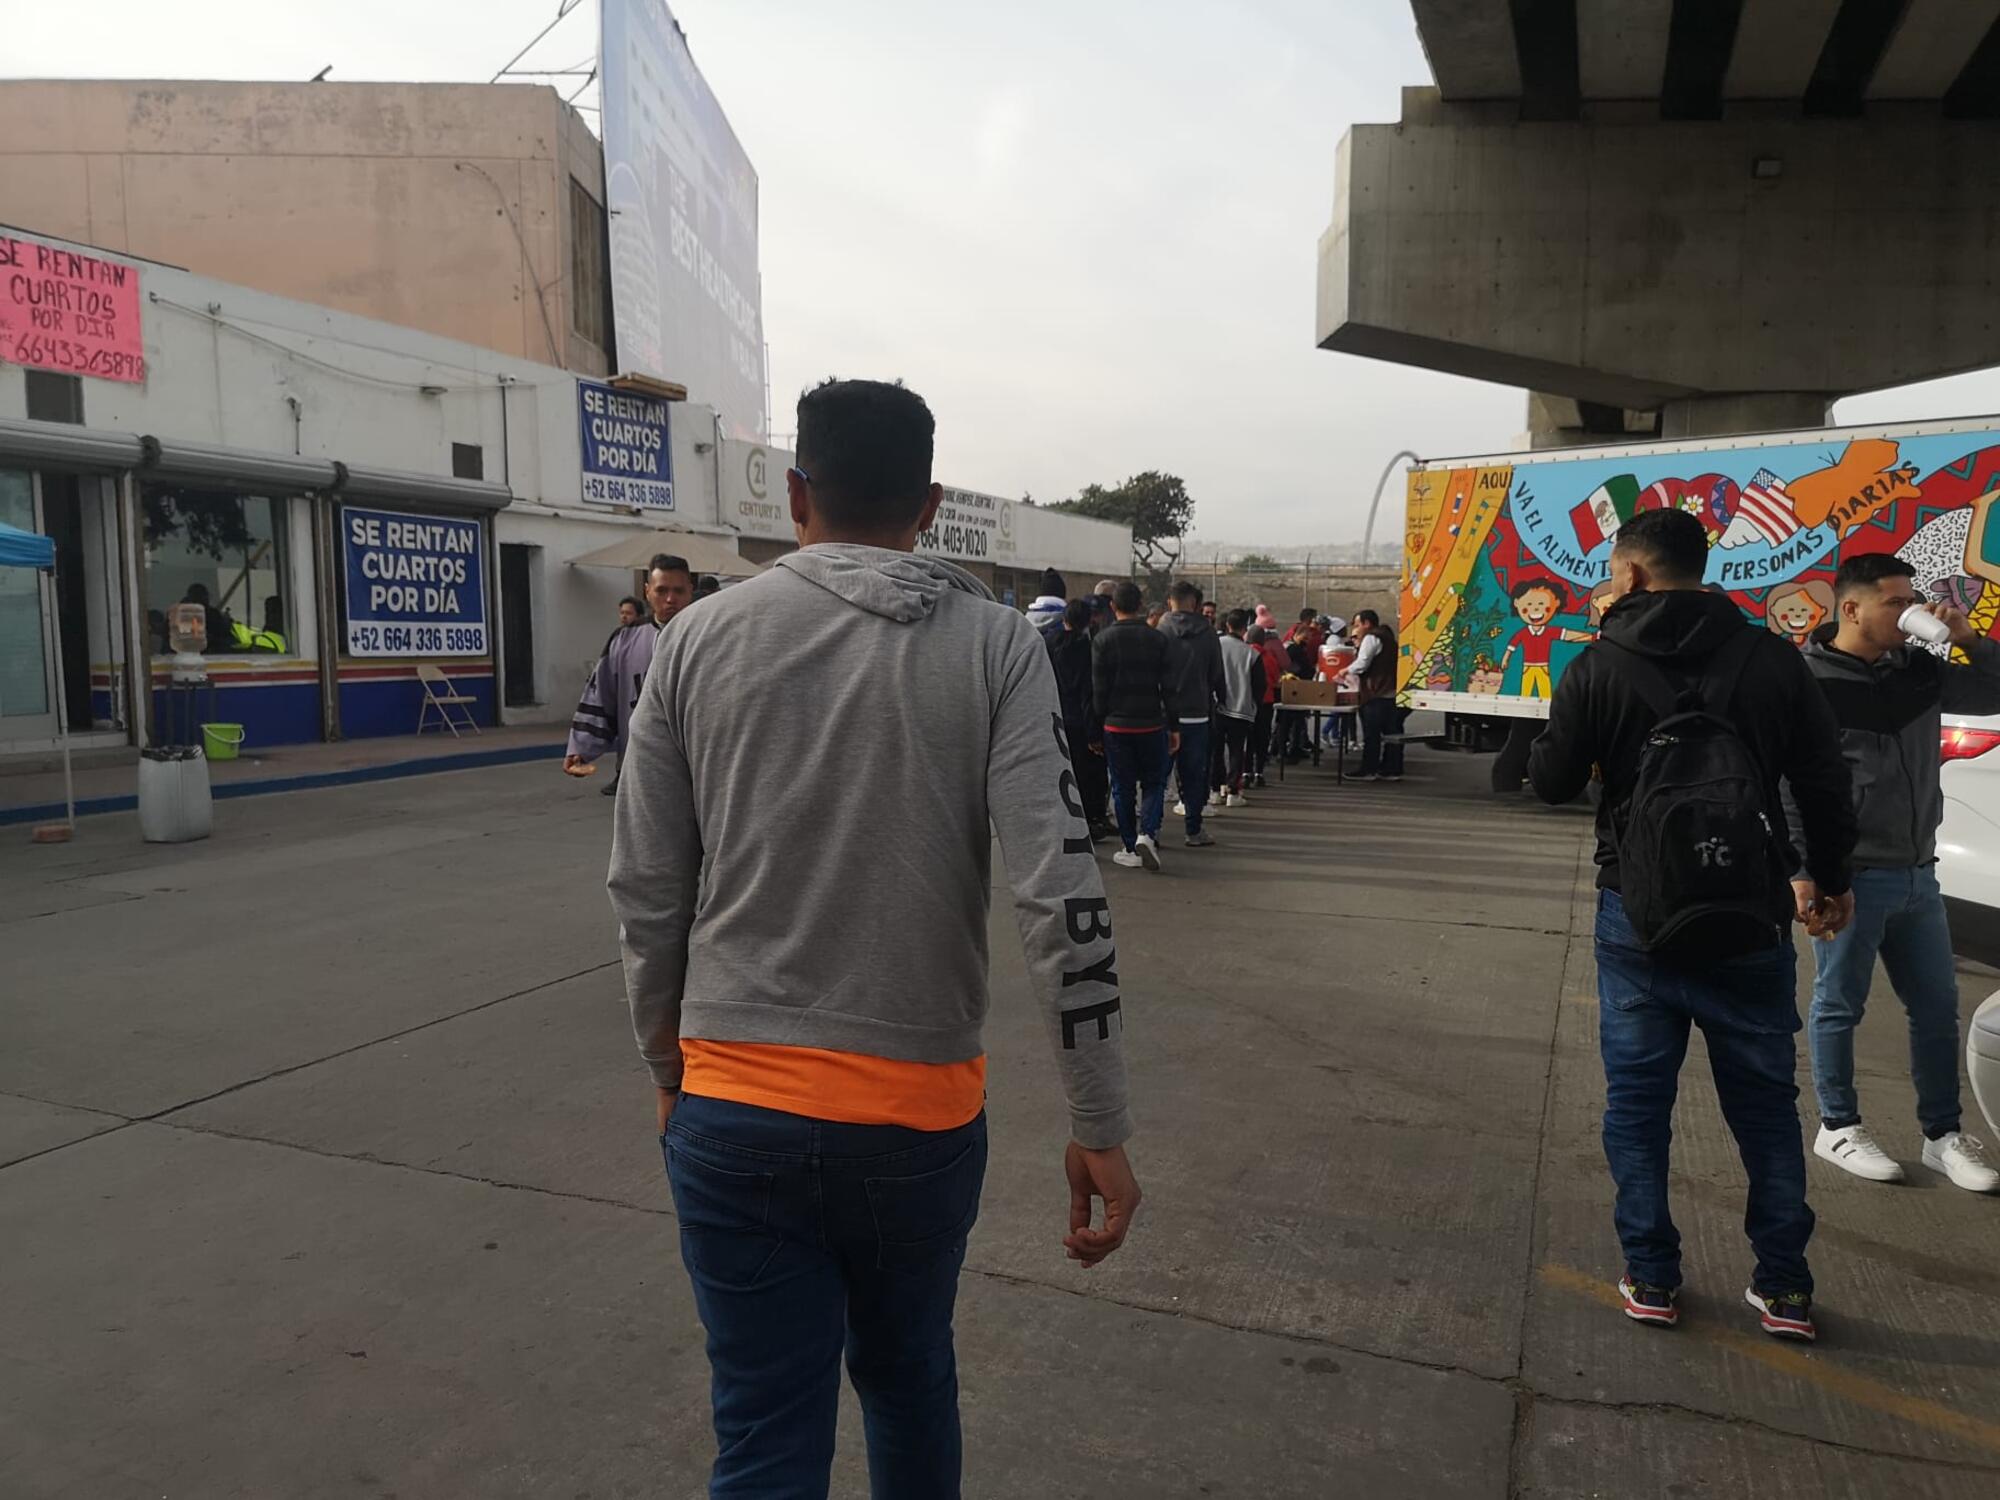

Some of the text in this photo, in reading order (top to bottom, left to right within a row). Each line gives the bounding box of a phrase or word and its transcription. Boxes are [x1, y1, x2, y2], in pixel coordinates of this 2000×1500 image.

[0, 236, 125, 288] SE RENTAN
[11, 274, 116, 320] CUARTOS
[32, 307, 63, 331] POR
[76, 314, 115, 341] DIA
[15, 332, 145, 380] 6643365898
[584, 390, 666, 426] SE RENTAN
[592, 418, 661, 450] CUARTOS
[598, 445, 657, 474] POR DÍA
[585, 479, 672, 505] +52 664 336 5898
[739, 501, 773, 518] CENTURY
[351, 518, 474, 554] SE RENTAN
[1515, 481, 1612, 578] VA EL ALIMENT
[1721, 460, 1921, 581] PERSONAS DIARIAS
[362, 552, 466, 584] CUARTOS
[371, 582, 460, 613] POR DÍA
[351, 627, 483, 650] +52 664 336 5898
[1062, 897, 1123, 1050] BYE
